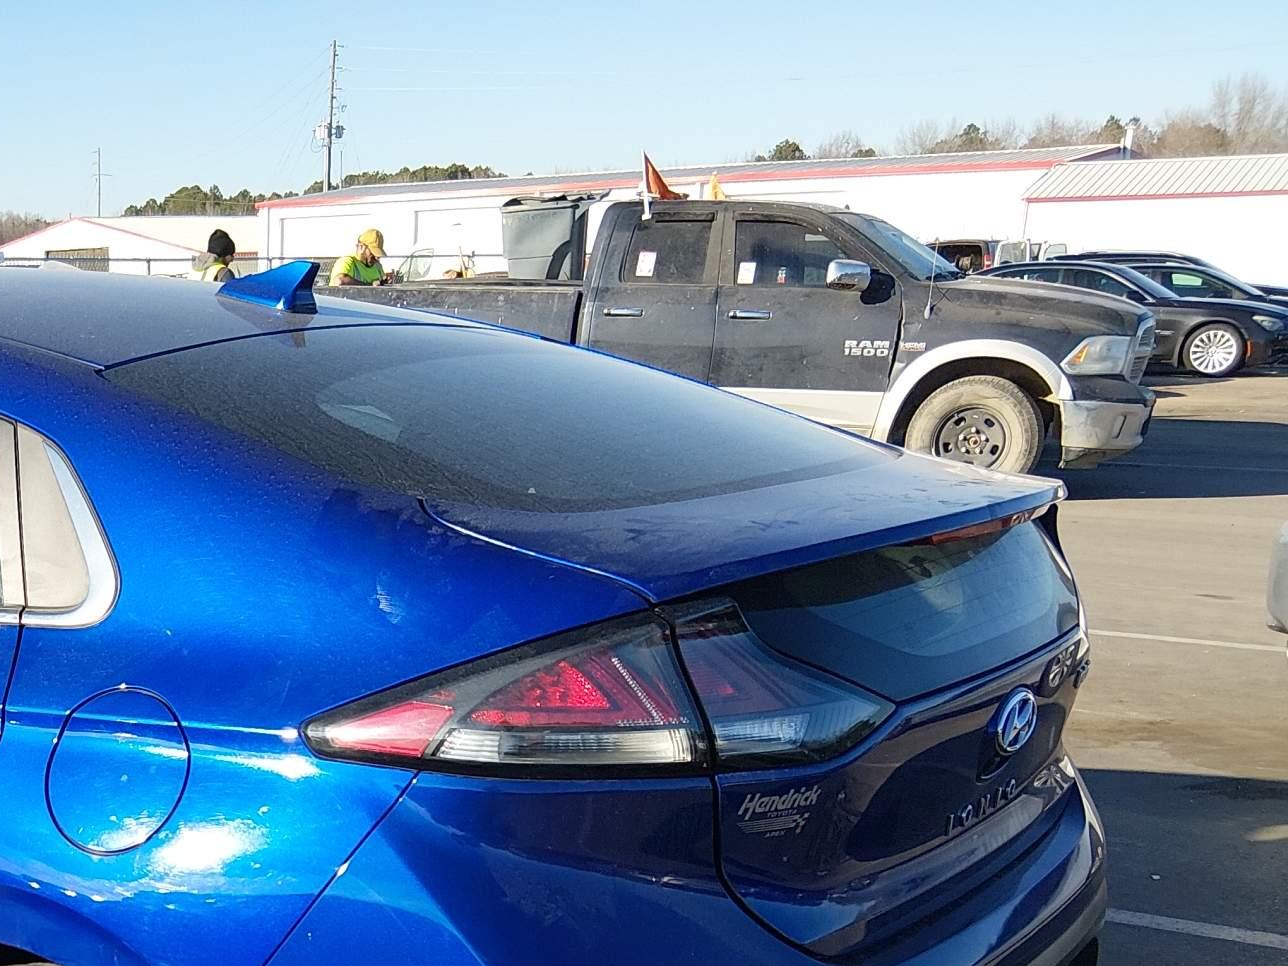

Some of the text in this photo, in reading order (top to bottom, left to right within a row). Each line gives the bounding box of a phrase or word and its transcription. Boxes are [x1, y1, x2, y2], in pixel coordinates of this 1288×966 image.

[843, 340, 890, 348] RAM
[844, 348, 889, 357] 1500
[737, 785, 822, 821] Hendrick
